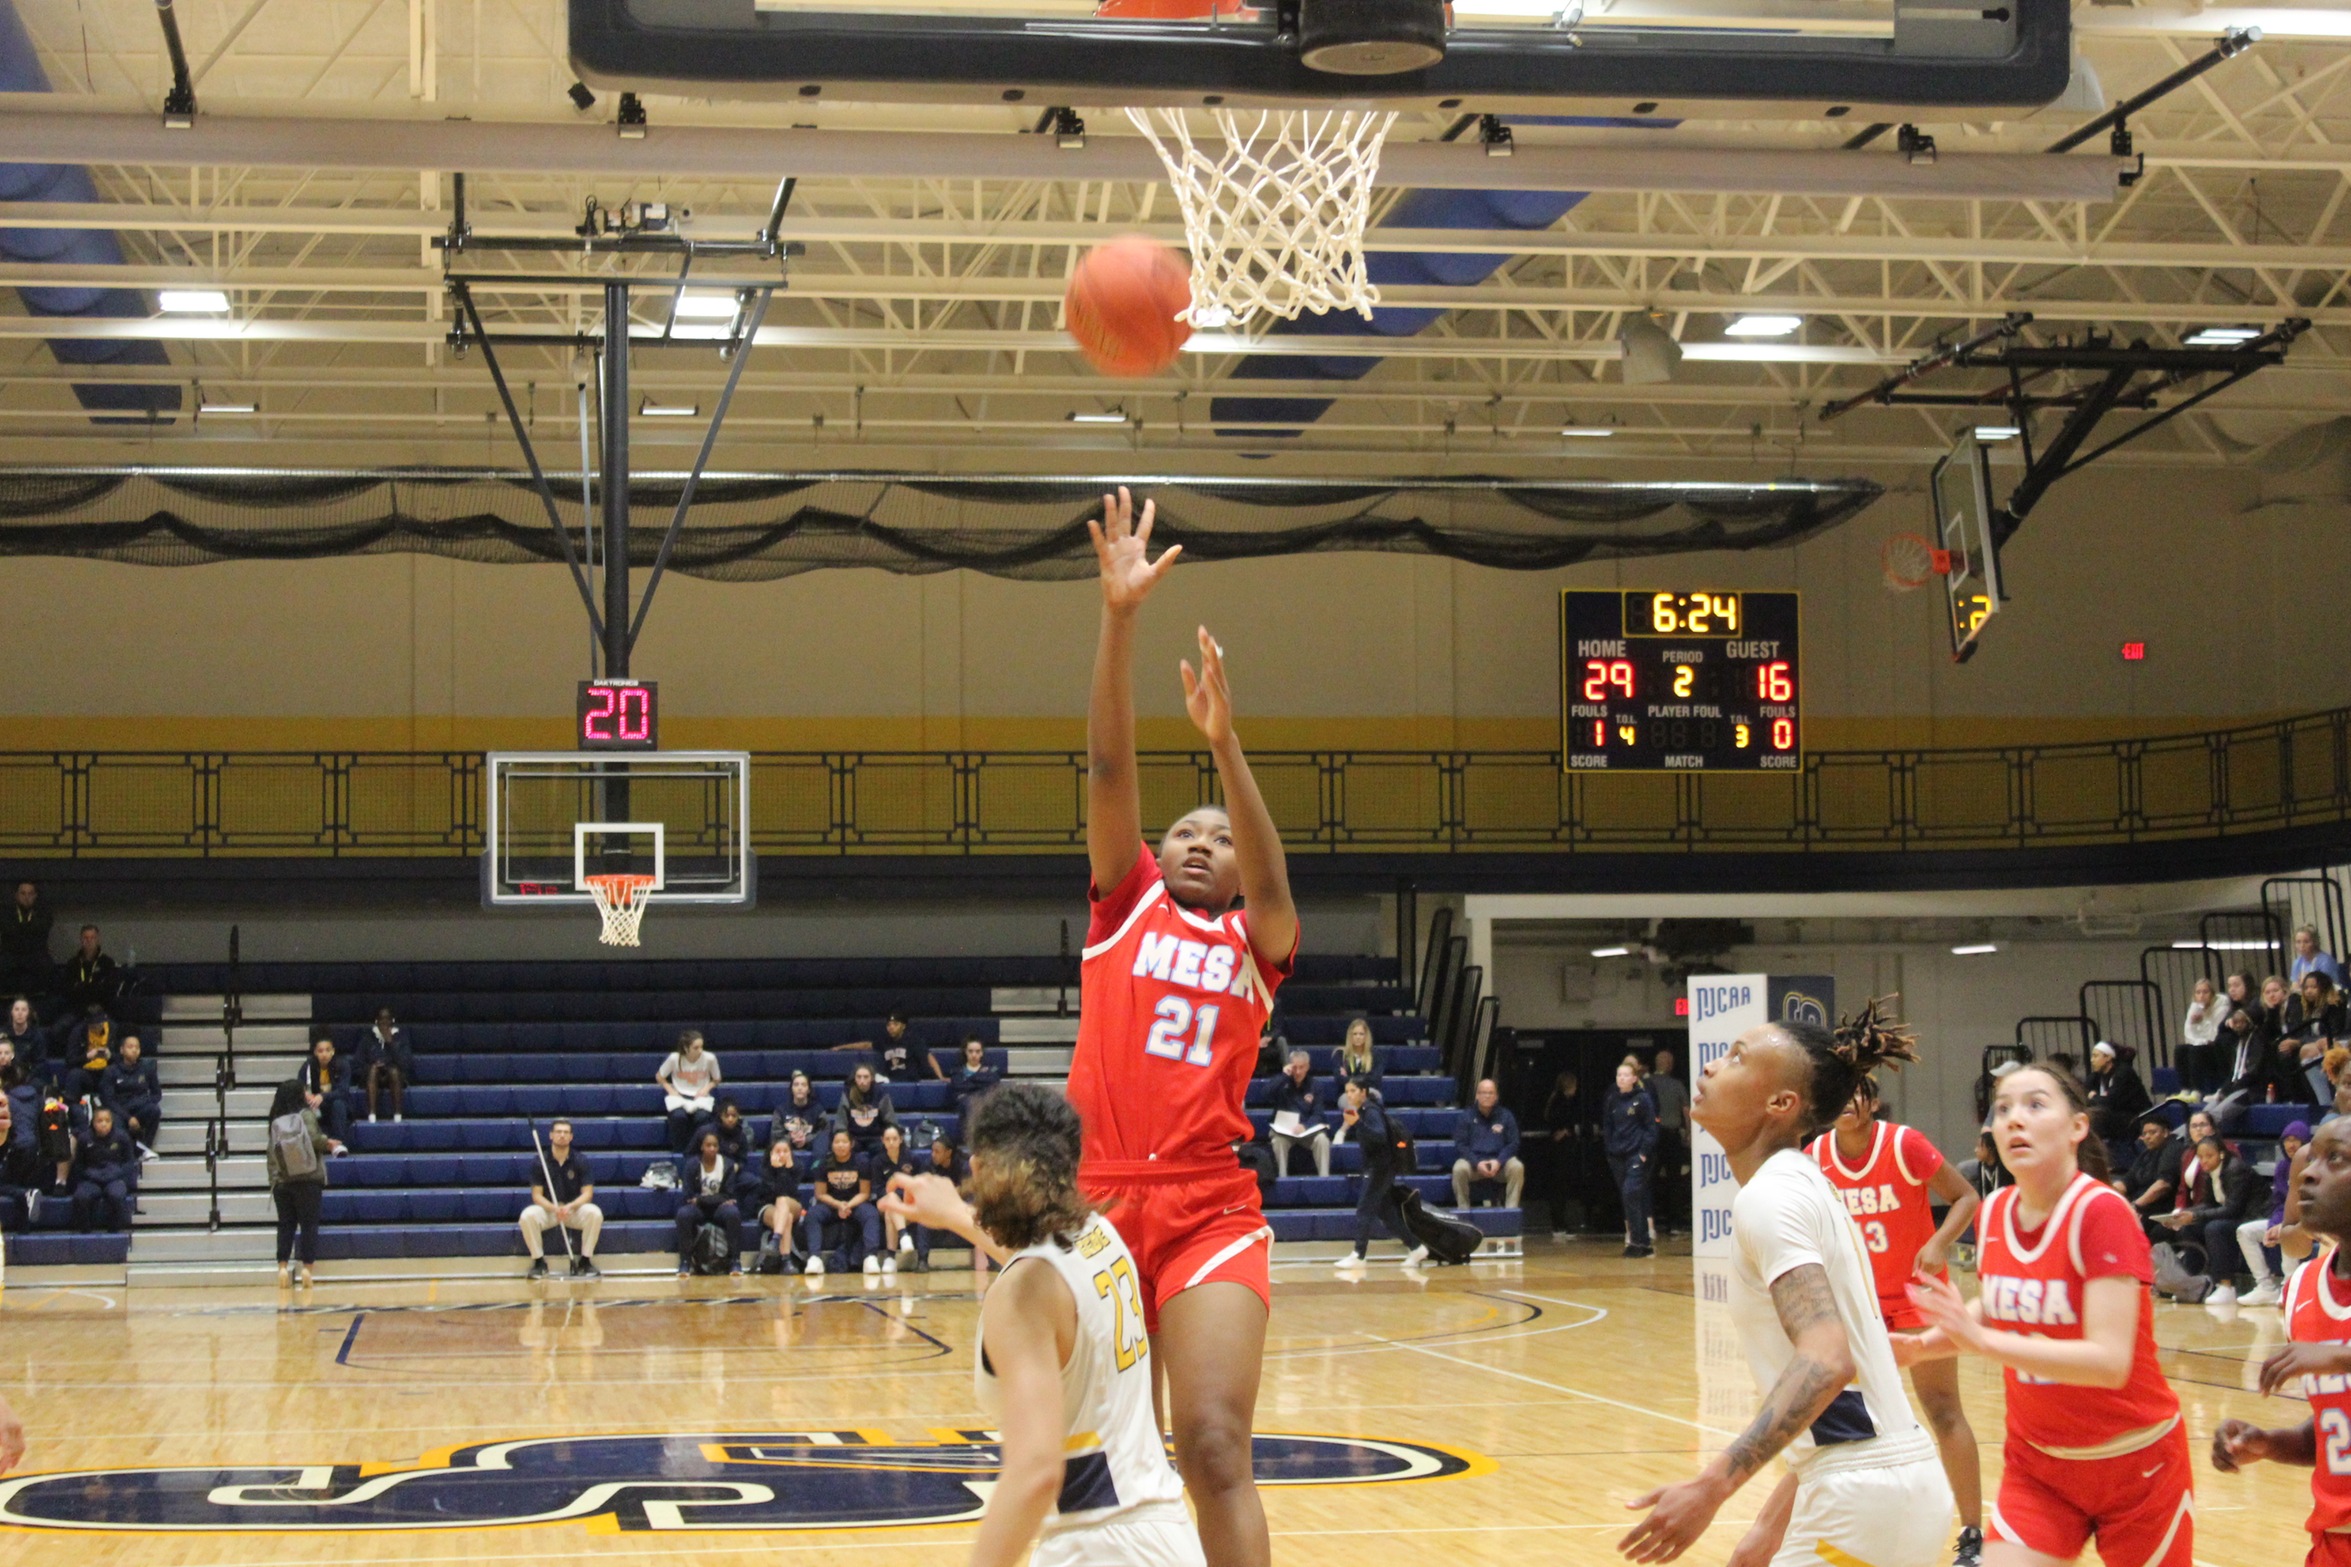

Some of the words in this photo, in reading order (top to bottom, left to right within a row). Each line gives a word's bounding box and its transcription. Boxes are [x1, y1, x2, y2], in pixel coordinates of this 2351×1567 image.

[1653, 593, 1737, 633] 6:24
[1578, 640, 1627, 658] HOME
[1662, 651, 1704, 663] PERIOD
[1726, 641, 1780, 659] GUEST
[1584, 660, 1635, 701] 29
[1673, 665, 1694, 698] 2
[1758, 662, 1792, 701] 16
[584, 687, 649, 740] 20
[1571, 705, 1608, 718] FOULS
[1648, 705, 1690, 718] PLAYER
[1693, 705, 1722, 718] FOUL
[1760, 706, 1796, 718] FOULS
[1594, 720, 1604, 746] 1
[1619, 726, 1636, 746] 4
[1735, 724, 1750, 748] 3
[1773, 719, 1793, 749] 0
[1571, 755, 1608, 768] SCORE
[1665, 756, 1704, 768] MATCH
[1760, 756, 1797, 768] SCORE
[1132, 932, 1254, 1004] MESA
[1696, 986, 1751, 1022] NJCAA
[1145, 994, 1220, 1068] 21
[1700, 1153, 1734, 1188] NJC
[1701, 1209, 1733, 1243] NJC
[1093, 1255, 1149, 1374] 23
